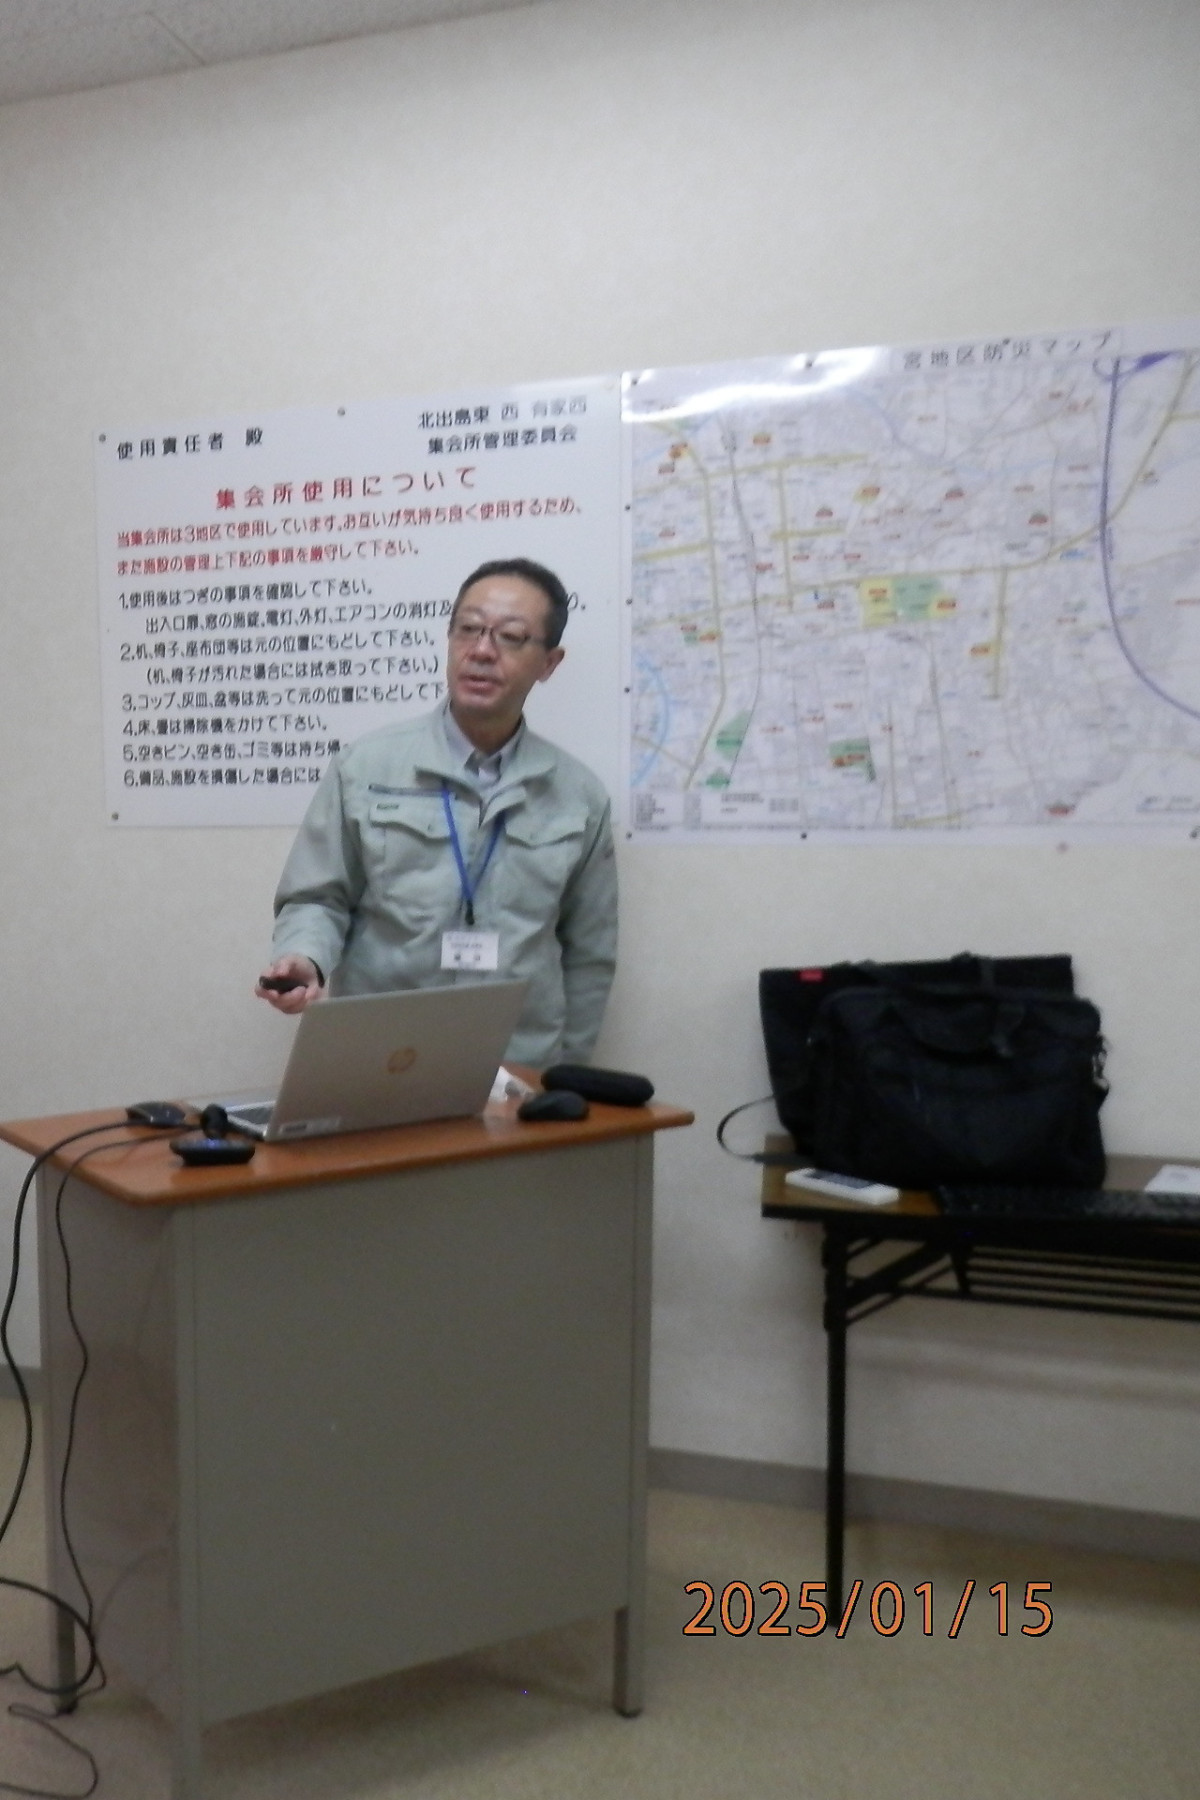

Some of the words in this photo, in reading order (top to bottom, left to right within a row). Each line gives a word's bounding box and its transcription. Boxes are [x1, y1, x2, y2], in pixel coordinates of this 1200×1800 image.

[117, 431, 223, 460] 使用責任者
[216, 466, 477, 510] 集会所使用について
